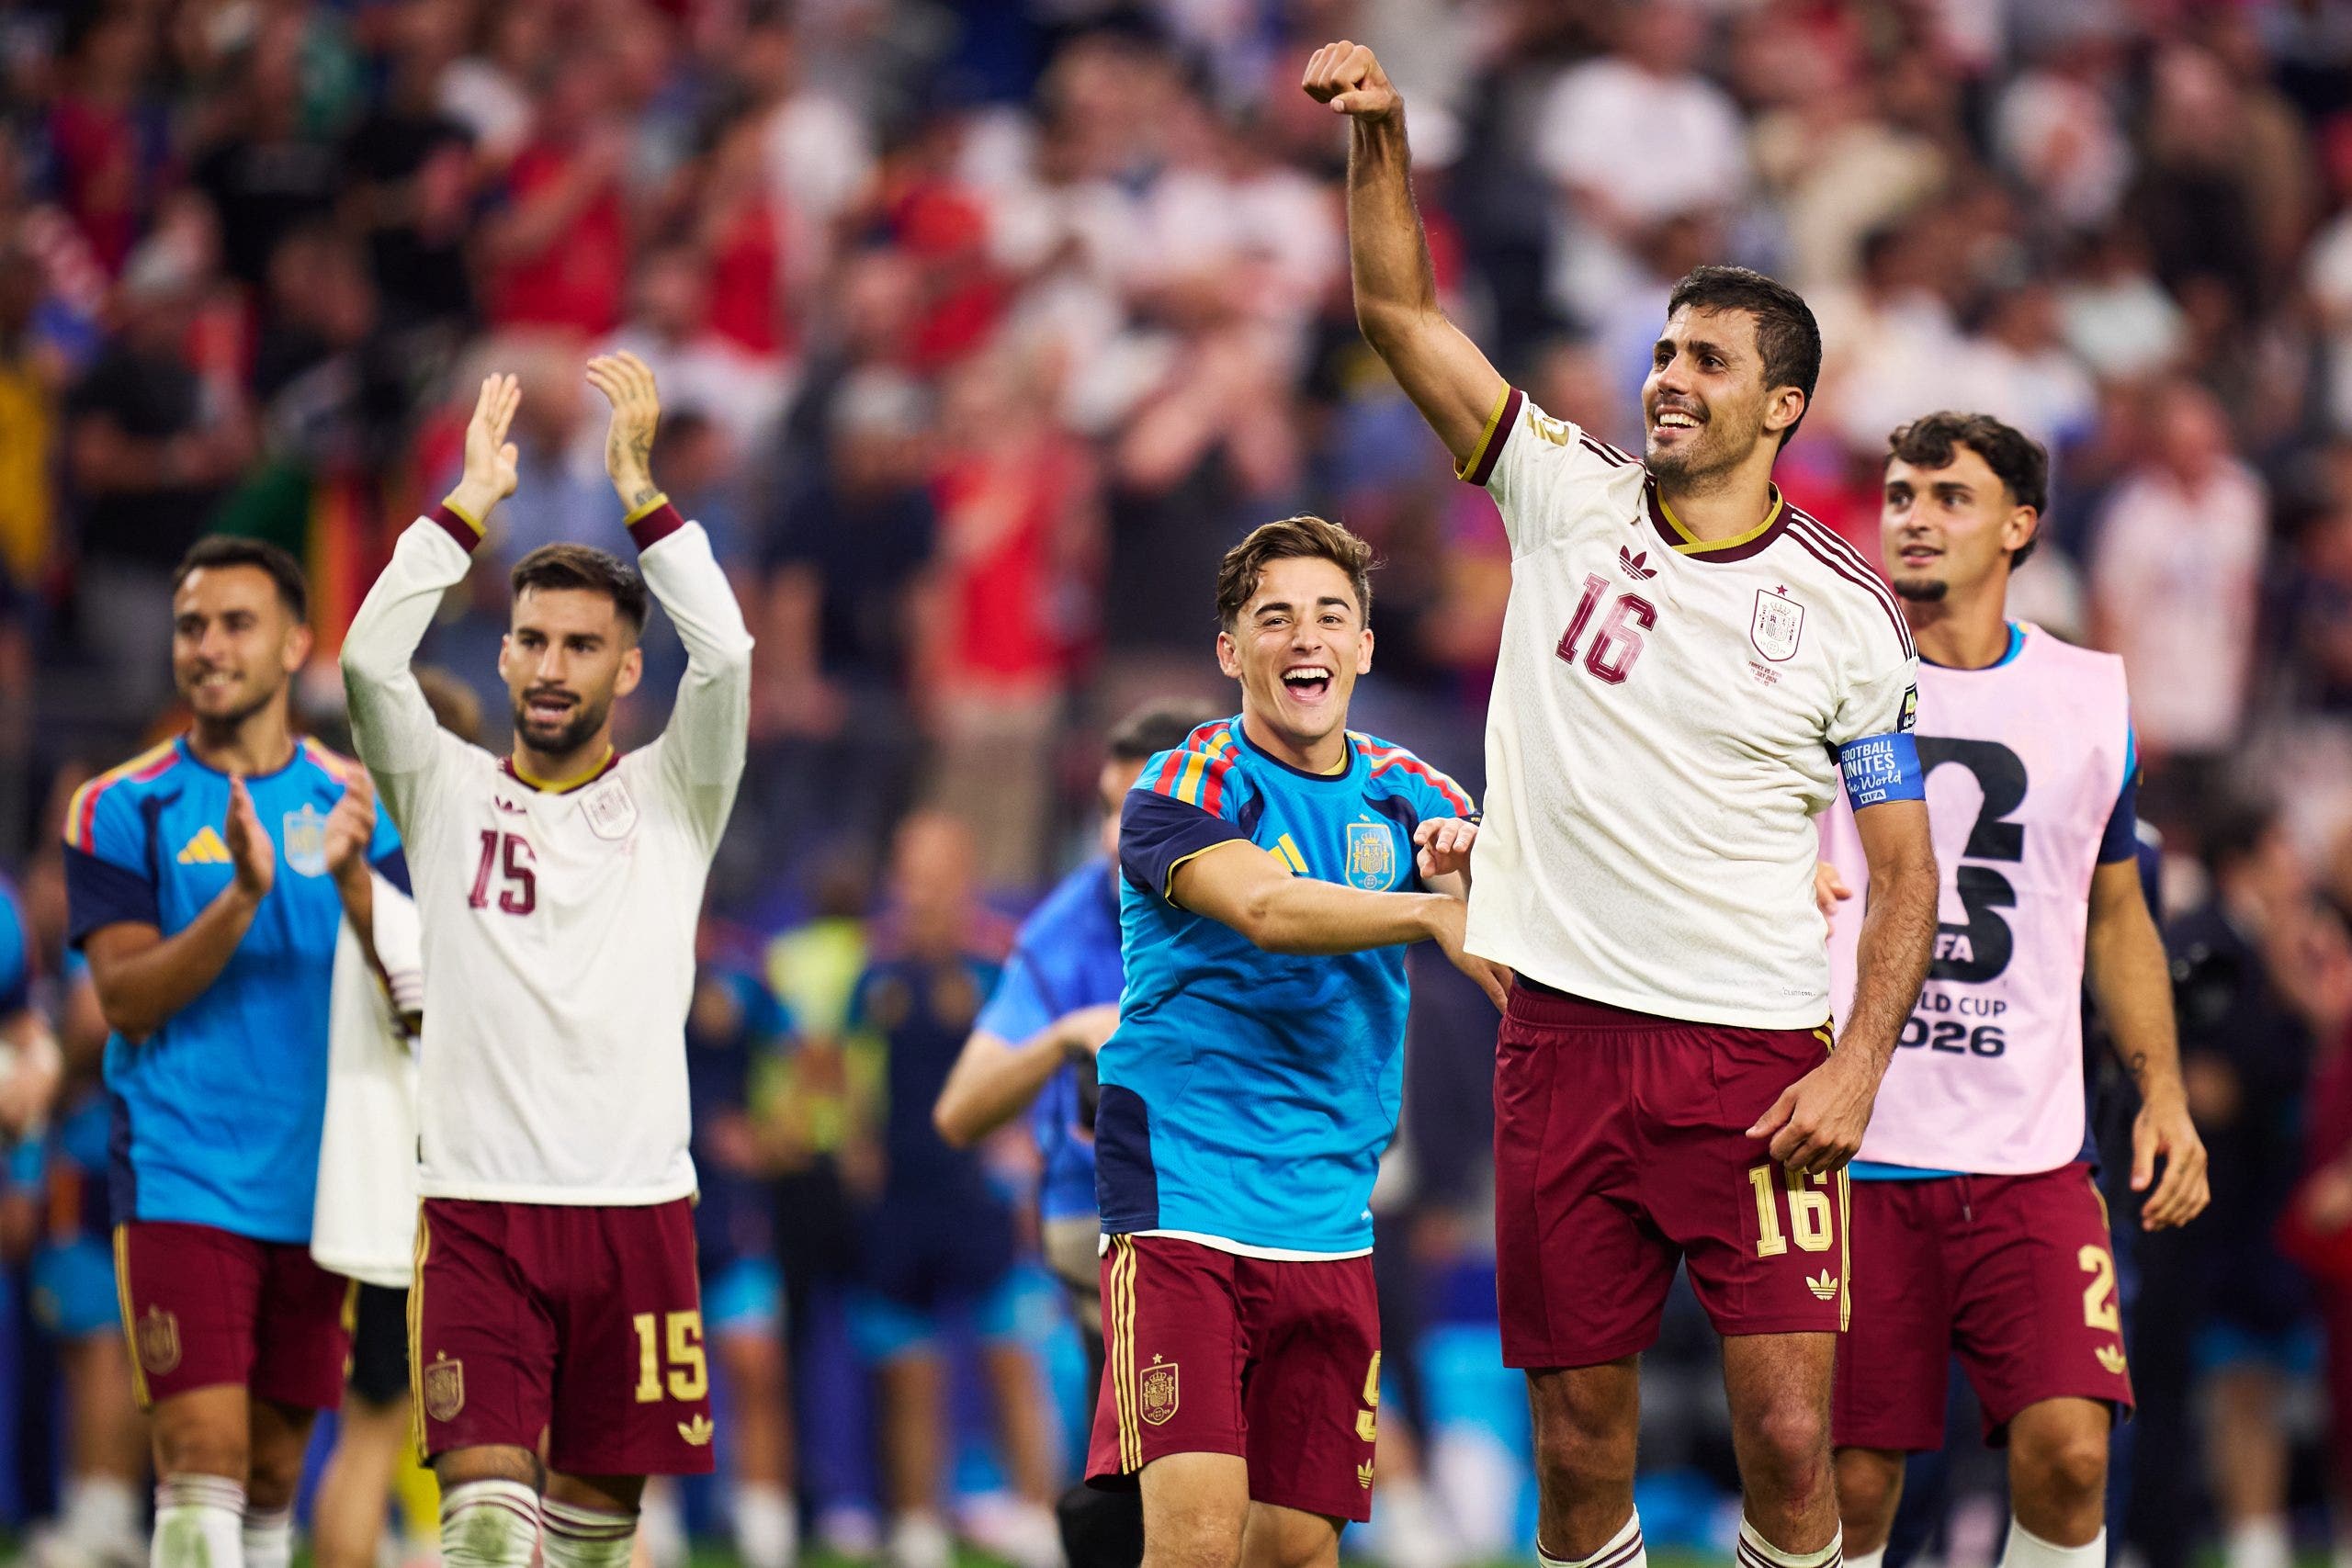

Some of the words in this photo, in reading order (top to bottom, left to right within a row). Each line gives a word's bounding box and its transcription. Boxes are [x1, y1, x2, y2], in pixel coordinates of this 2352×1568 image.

[1555, 571, 1657, 685] 16
[1841, 739, 1894, 762] FOOTBALL
[1843, 752, 1896, 780] UNITES
[1860, 769, 1903, 791] World
[1860, 790, 1885, 804] FIFA
[468, 829, 537, 916] 15
[1934, 932, 1975, 963] FA
[1959, 997, 2007, 1018] CUP
[1898, 1017, 2007, 1058] 026
[1748, 1164, 1834, 1258] 16
[2078, 1245, 2119, 1333] 2
[633, 1310, 709, 1404] 15
